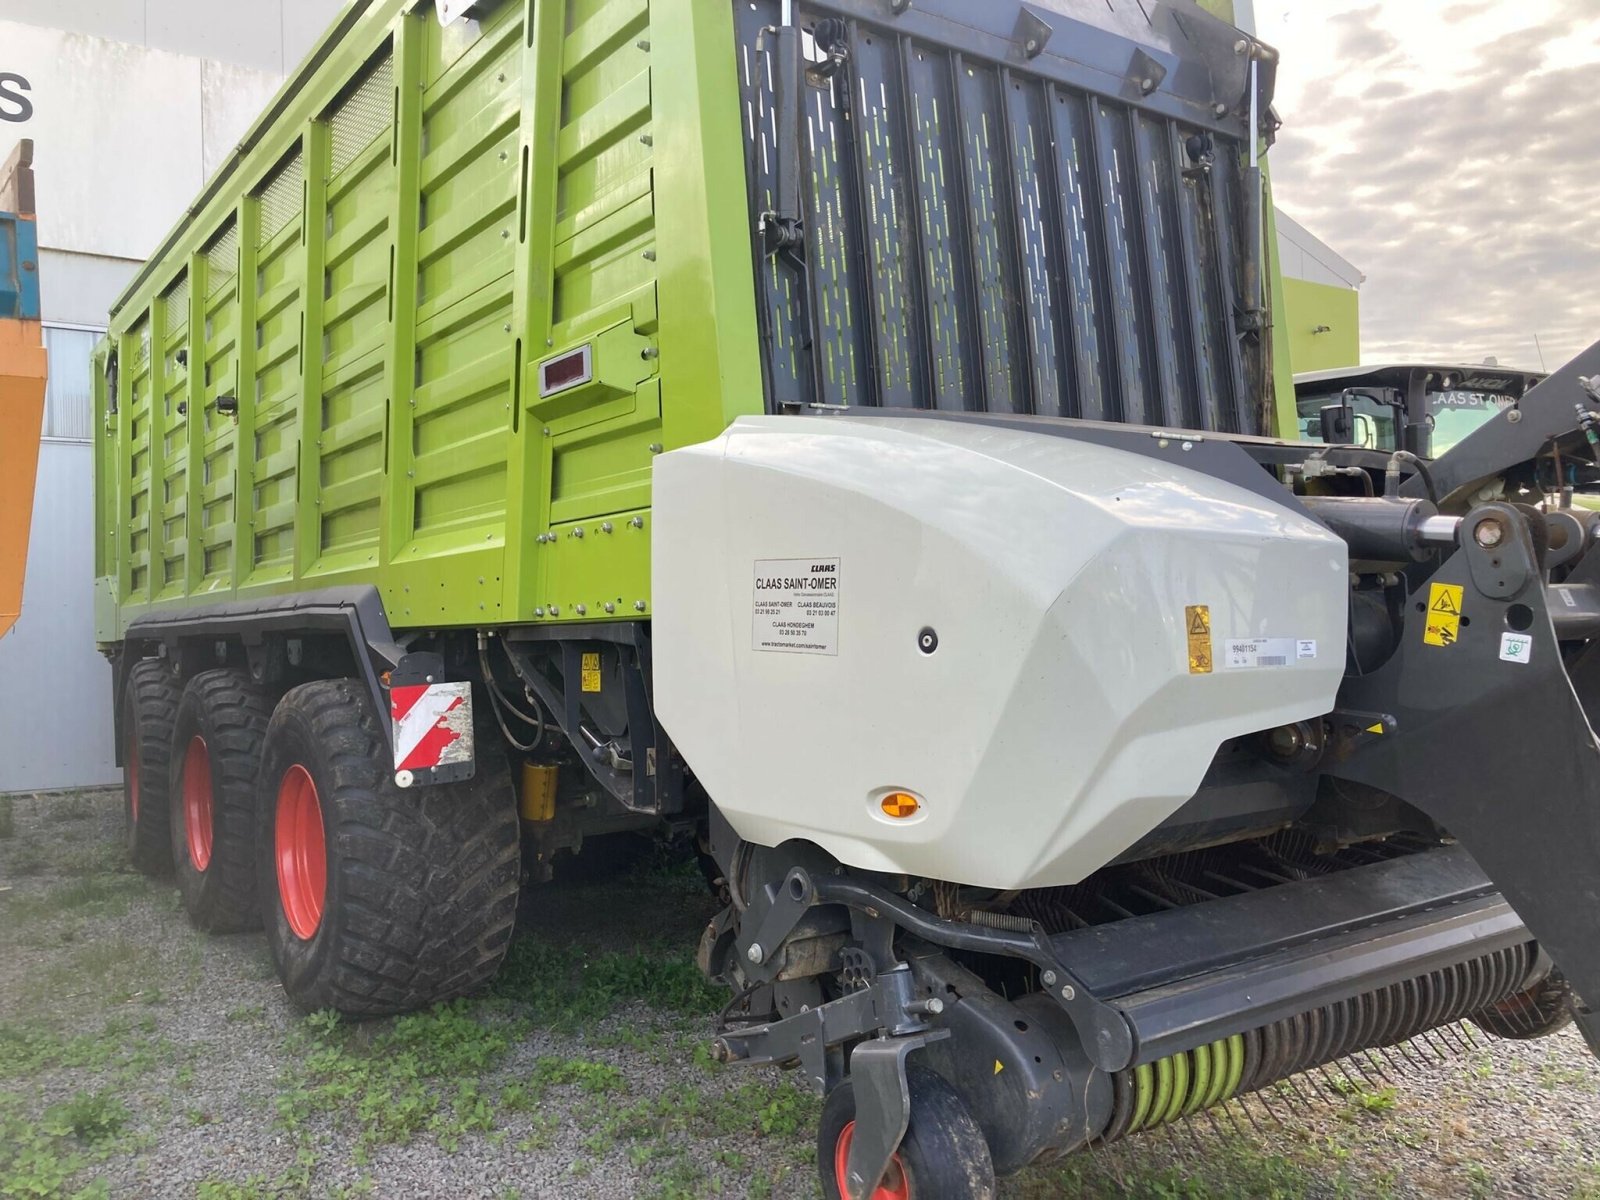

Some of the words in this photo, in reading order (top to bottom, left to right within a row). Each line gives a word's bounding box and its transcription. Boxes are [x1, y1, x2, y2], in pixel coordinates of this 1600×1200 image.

[0, 72, 33, 122] S
[1469, 393, 1485, 405] ST
[811, 564, 836, 572] CLAAS
[755, 578, 782, 590] CLAAS
[783, 577, 837, 590] SAINT-OMER
